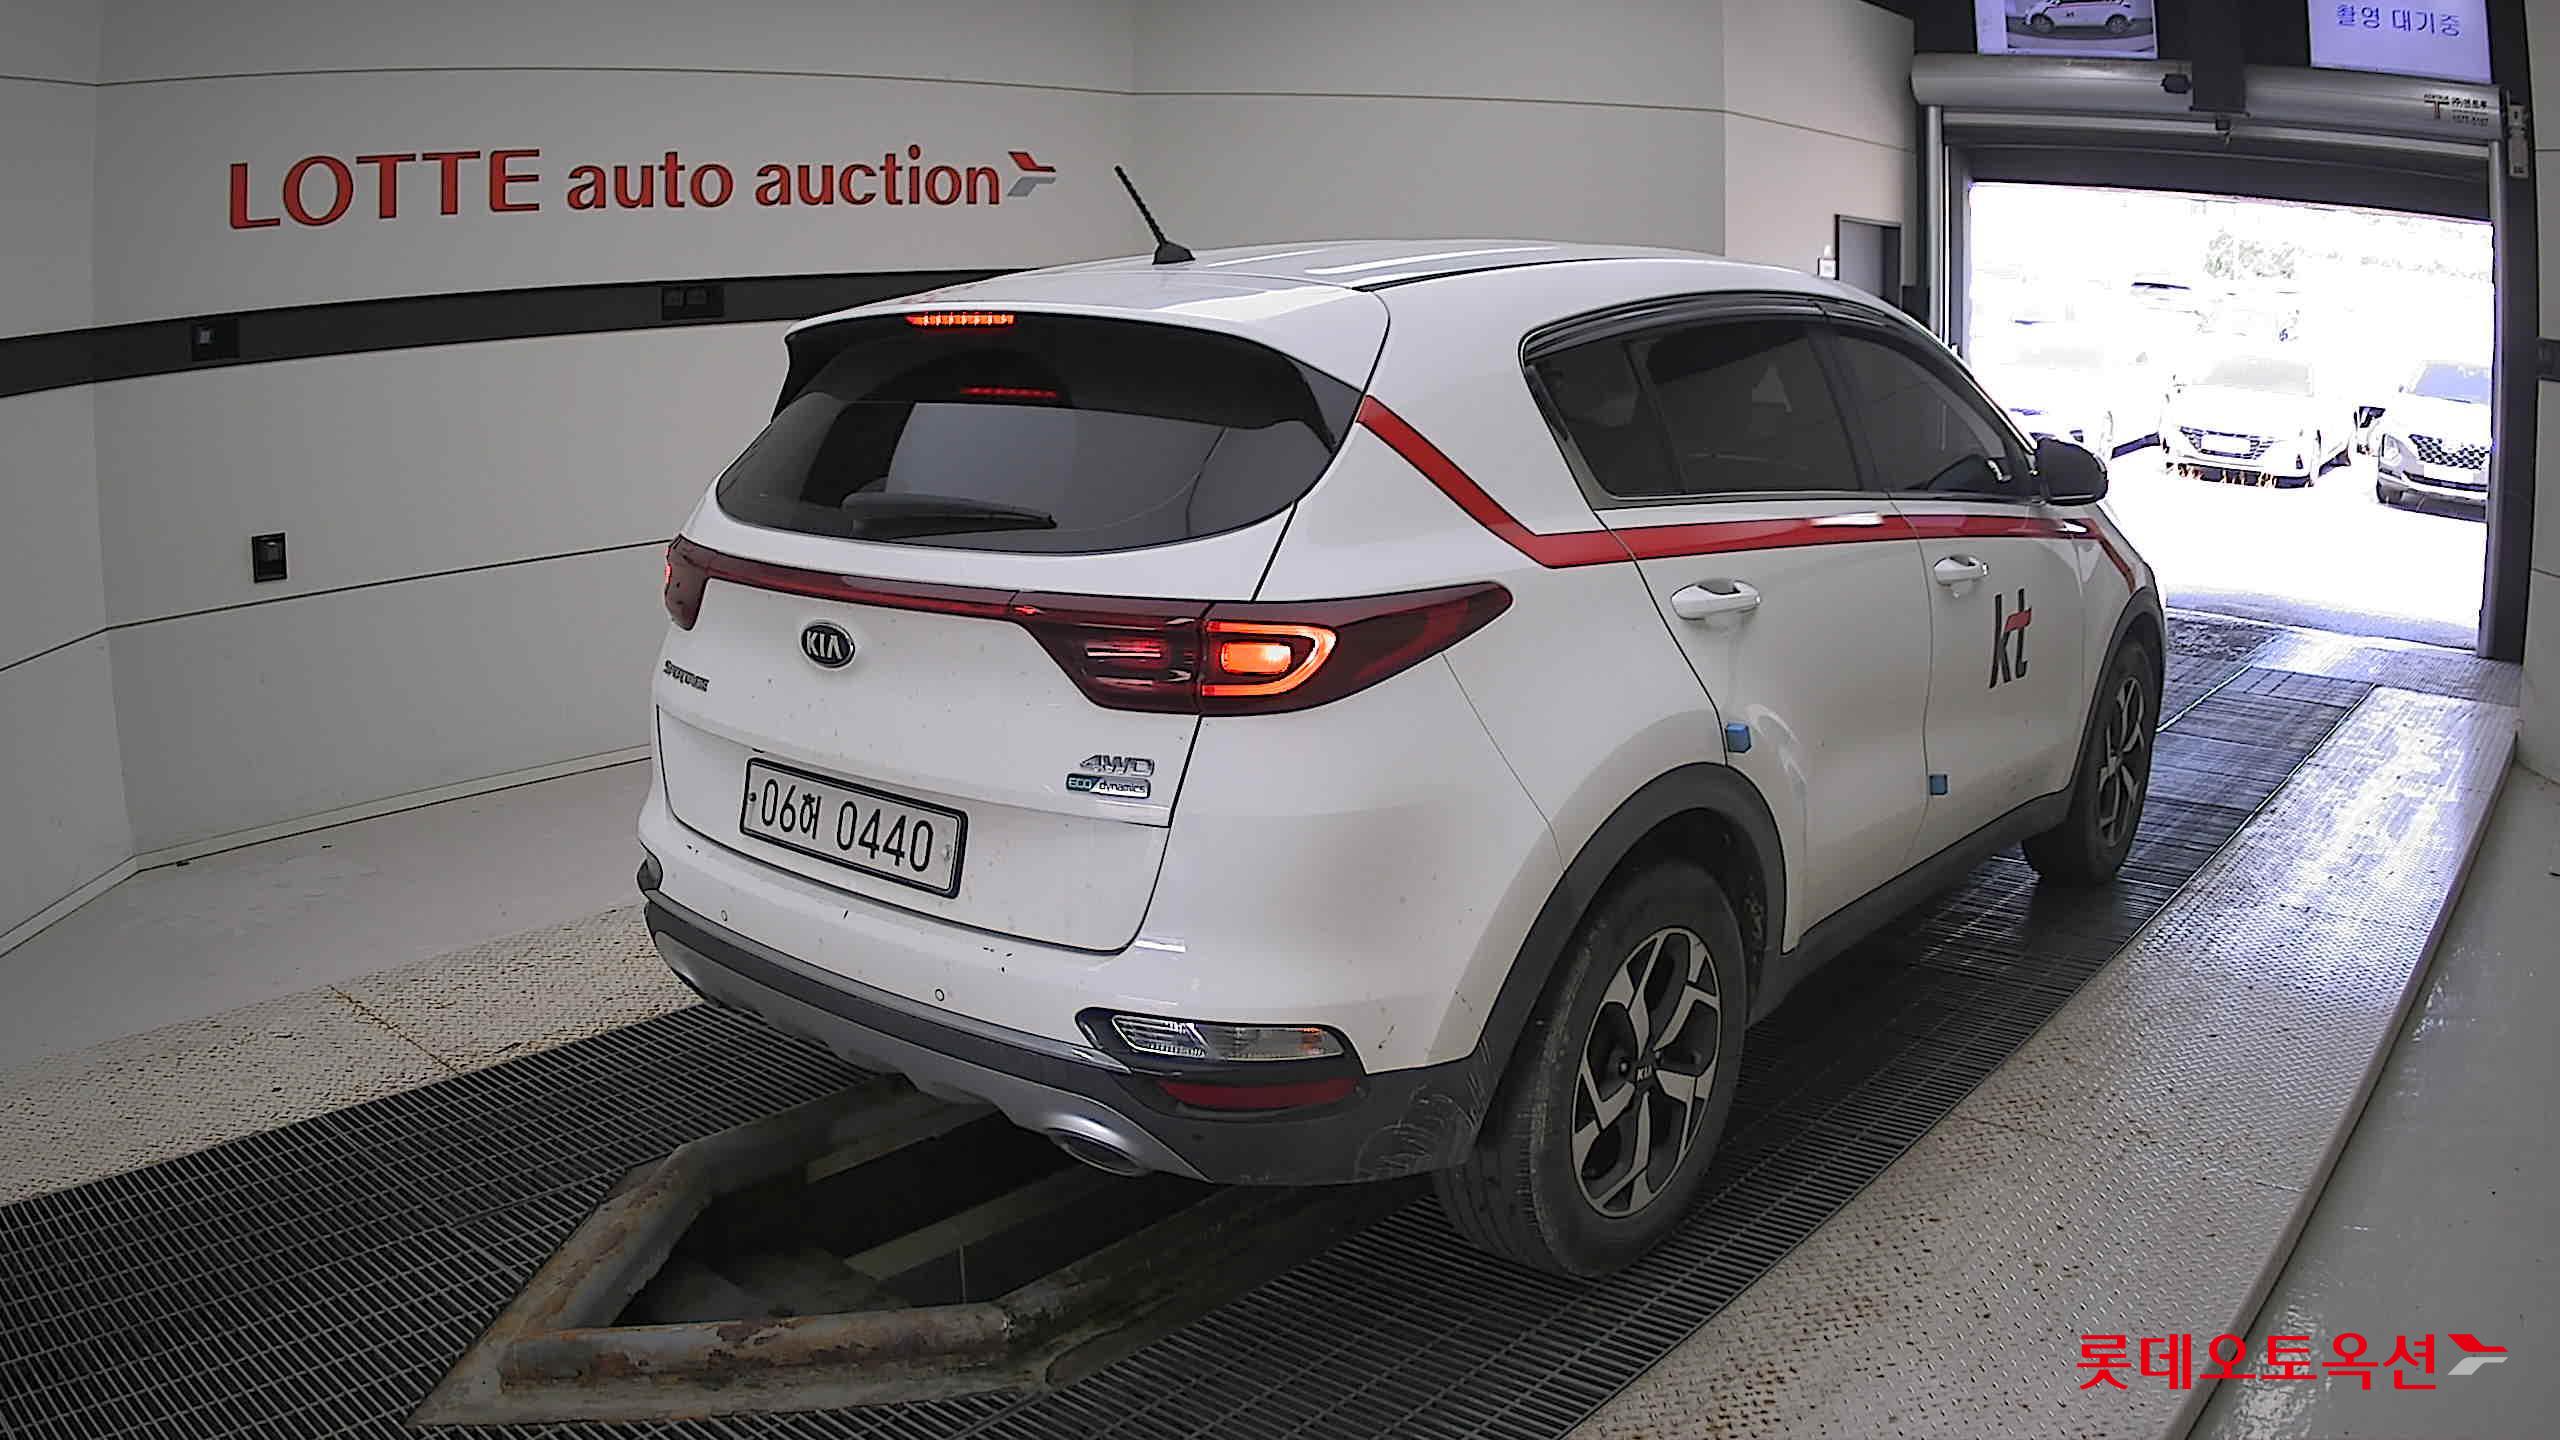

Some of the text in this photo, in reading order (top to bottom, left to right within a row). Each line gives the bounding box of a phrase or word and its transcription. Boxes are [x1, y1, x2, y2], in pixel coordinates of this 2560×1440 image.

[2337, 4, 2461, 37] 촬영 대기중
[230, 144, 1000, 229] LOTTE auto auction
[804, 630, 843, 660] KIA
[1989, 587, 2032, 689] kt
[1079, 754, 1154, 777] 4WD
[1099, 780, 1146, 793] dynamics
[761, 778, 934, 872] 06허 0440
